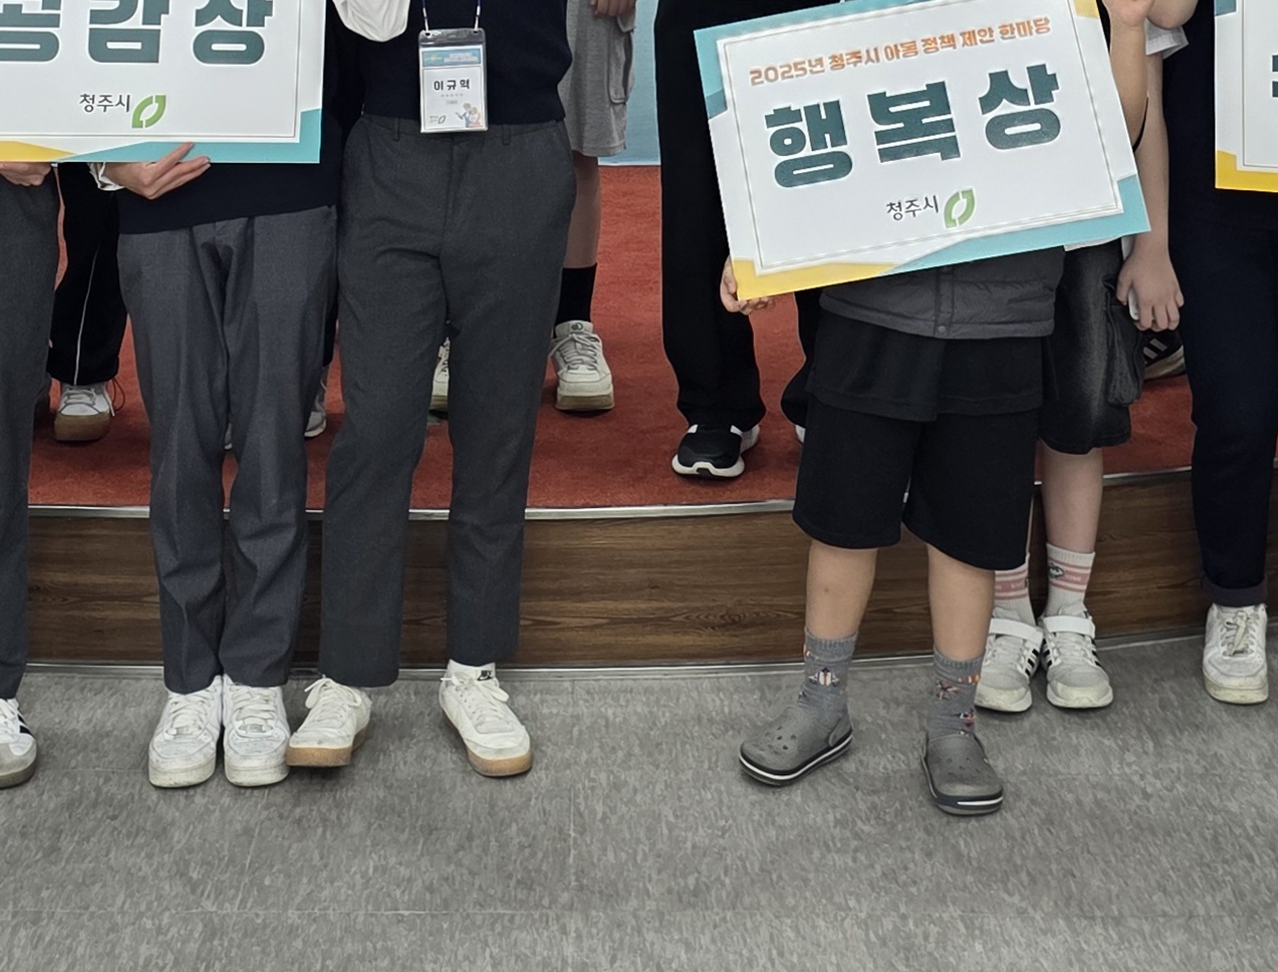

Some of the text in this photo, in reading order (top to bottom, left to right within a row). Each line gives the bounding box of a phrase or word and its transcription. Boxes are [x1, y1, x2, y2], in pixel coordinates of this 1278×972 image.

[749, 16, 1051, 86] 2025년 청주시 아동 정책 제안 한마당
[79, 93, 131, 114] 청주시
[886, 195, 940, 222] 청주시
